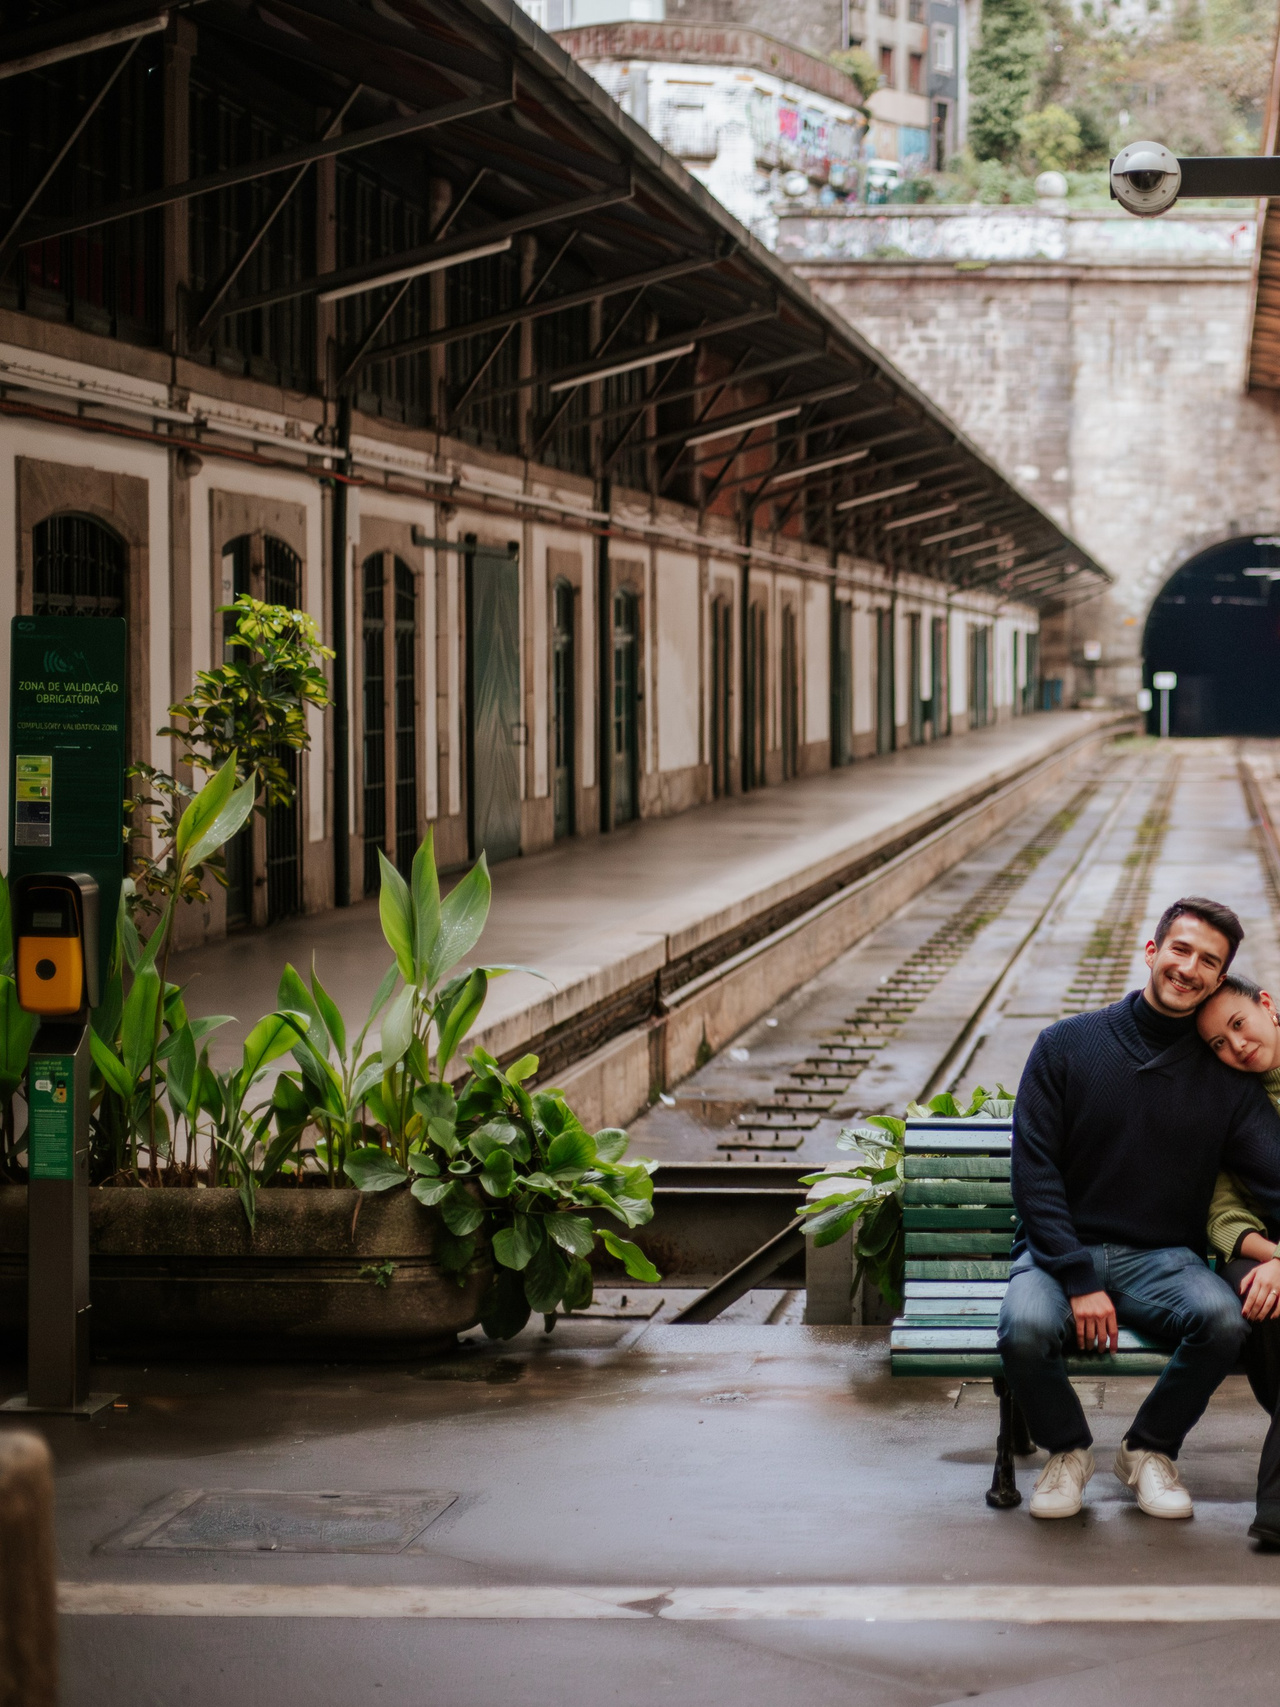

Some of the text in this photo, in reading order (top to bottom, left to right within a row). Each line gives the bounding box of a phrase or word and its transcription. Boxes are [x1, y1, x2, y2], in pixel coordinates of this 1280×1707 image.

[18, 681, 119, 695] ZONA DE VALIDAÇÃO
[36, 692, 100, 705] OBRIGATÓRIA
[16, 721, 118, 732] COMPULSORY VALIDATION ZONE
